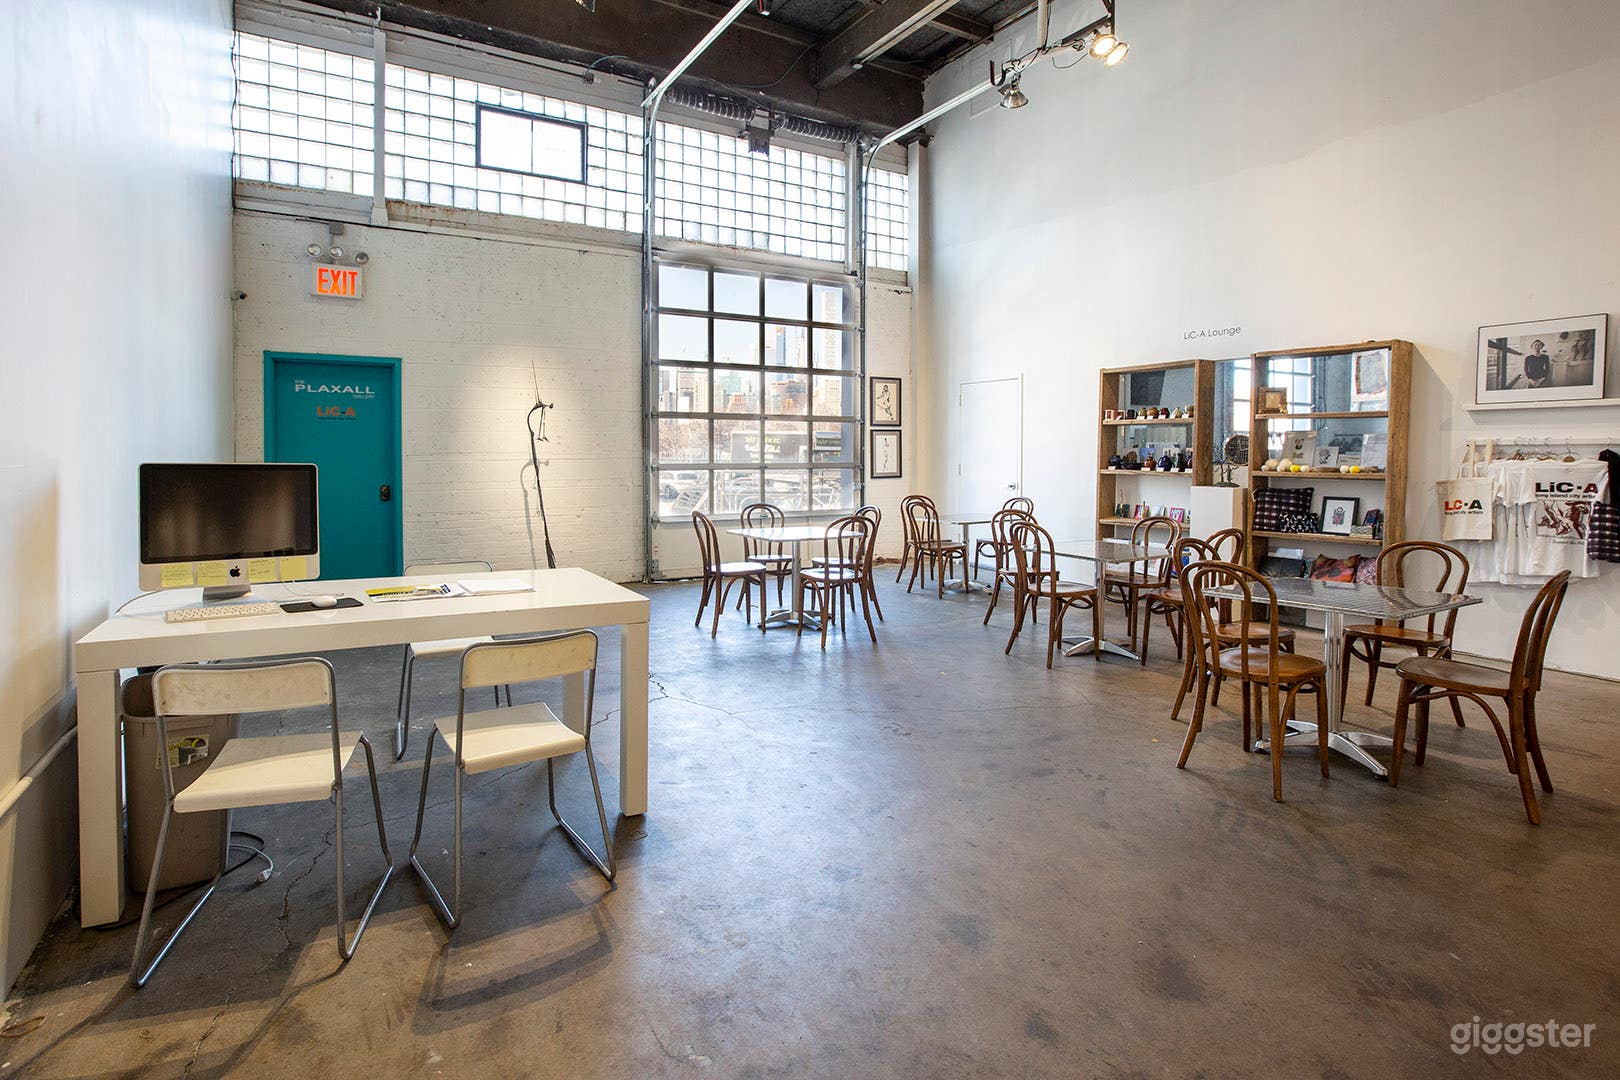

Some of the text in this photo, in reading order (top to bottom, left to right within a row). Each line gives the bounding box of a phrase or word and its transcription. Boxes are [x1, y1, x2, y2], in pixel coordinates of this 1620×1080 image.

[317, 267, 358, 297] EXIT
[1208, 327, 1241, 337] Lounge
[295, 384, 375, 394] PLAXALL
